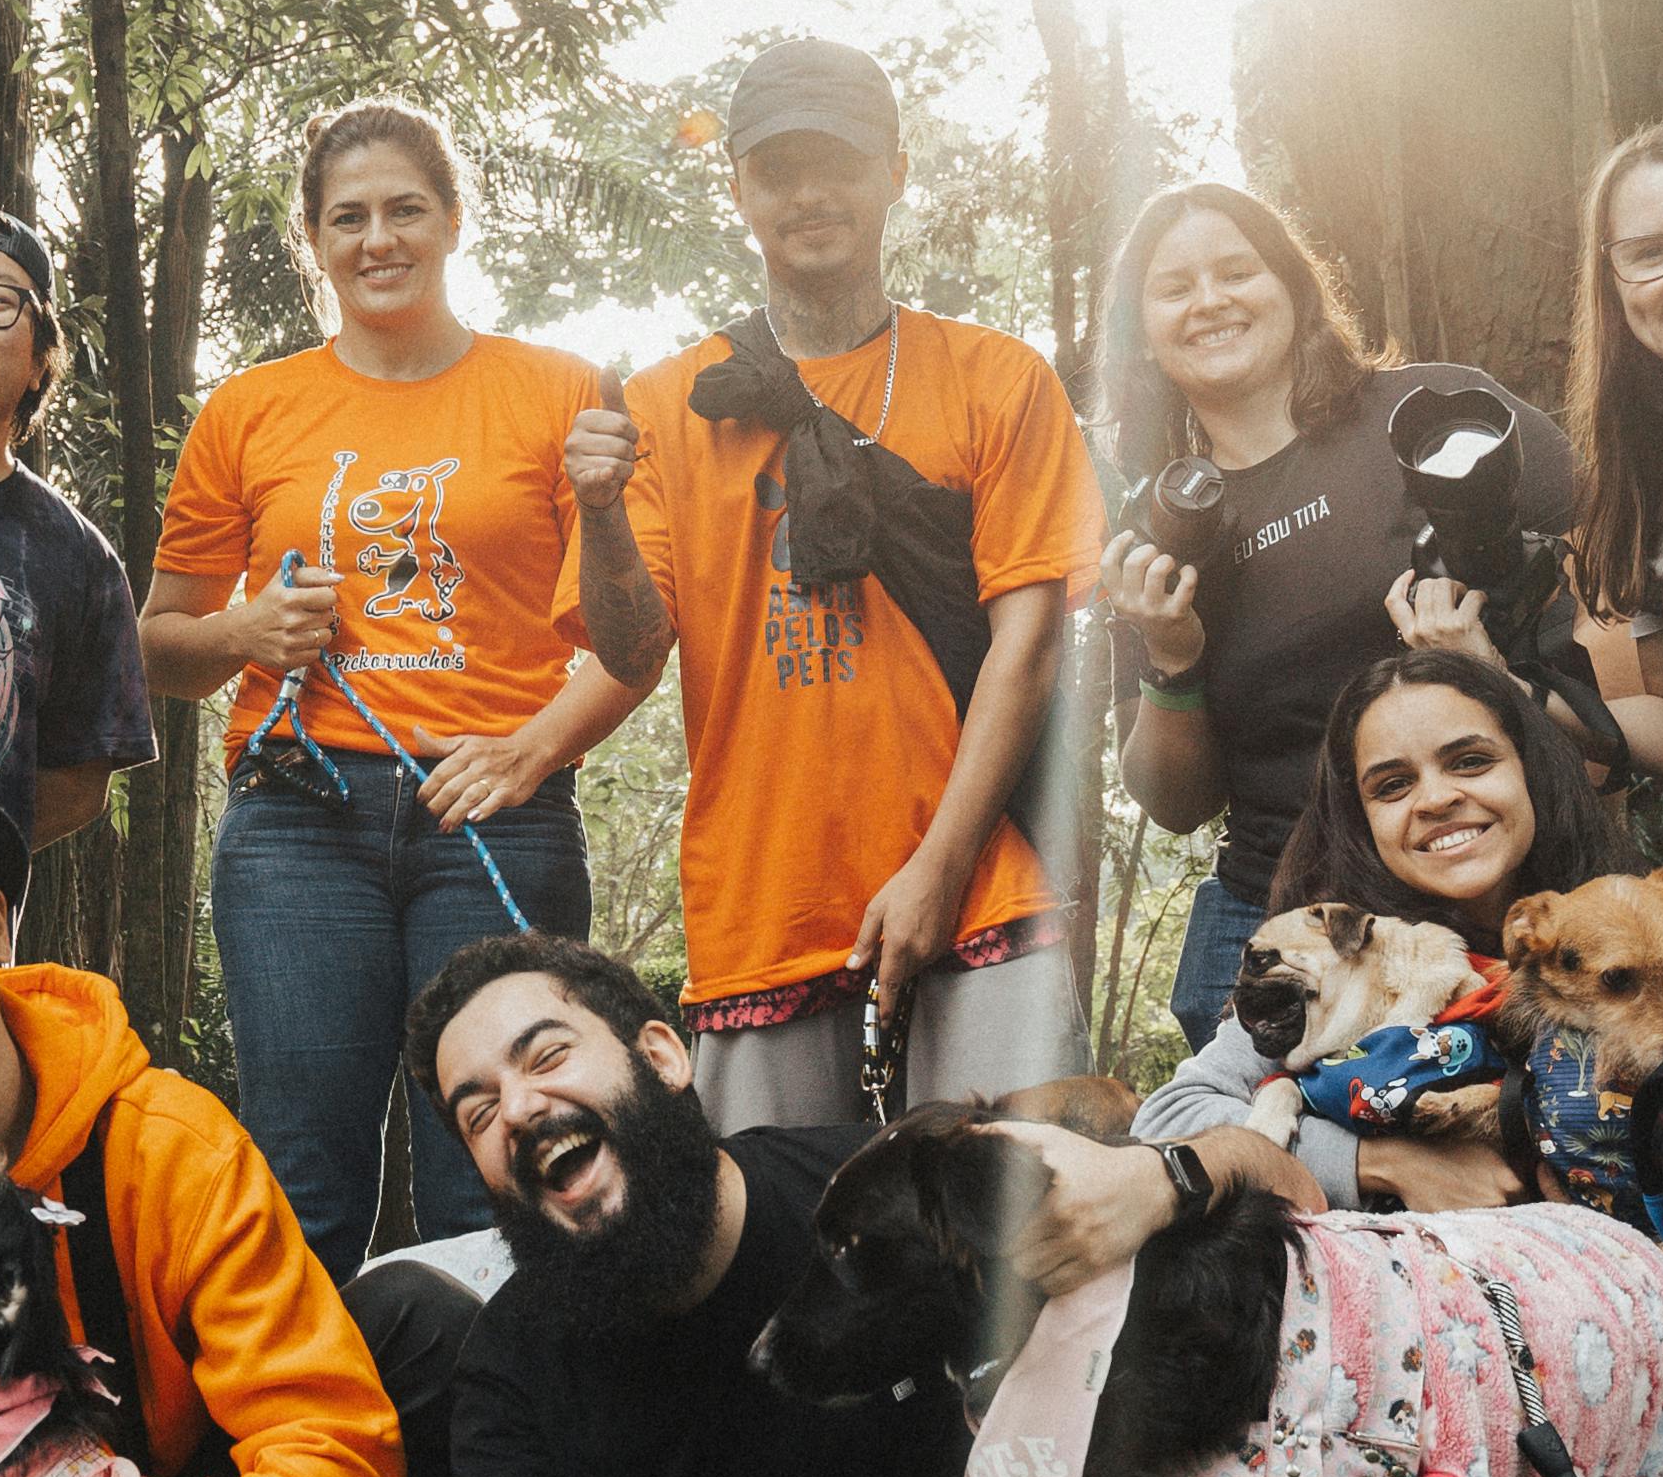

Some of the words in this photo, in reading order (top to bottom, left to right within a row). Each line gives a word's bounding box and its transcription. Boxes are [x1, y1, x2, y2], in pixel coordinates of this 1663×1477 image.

[1234, 537, 1253, 565] EU
[1256, 516, 1290, 551] SOU
[1292, 494, 1331, 530] TITÃ
[765, 613, 864, 655] PELOS
[777, 648, 855, 690] PETS
